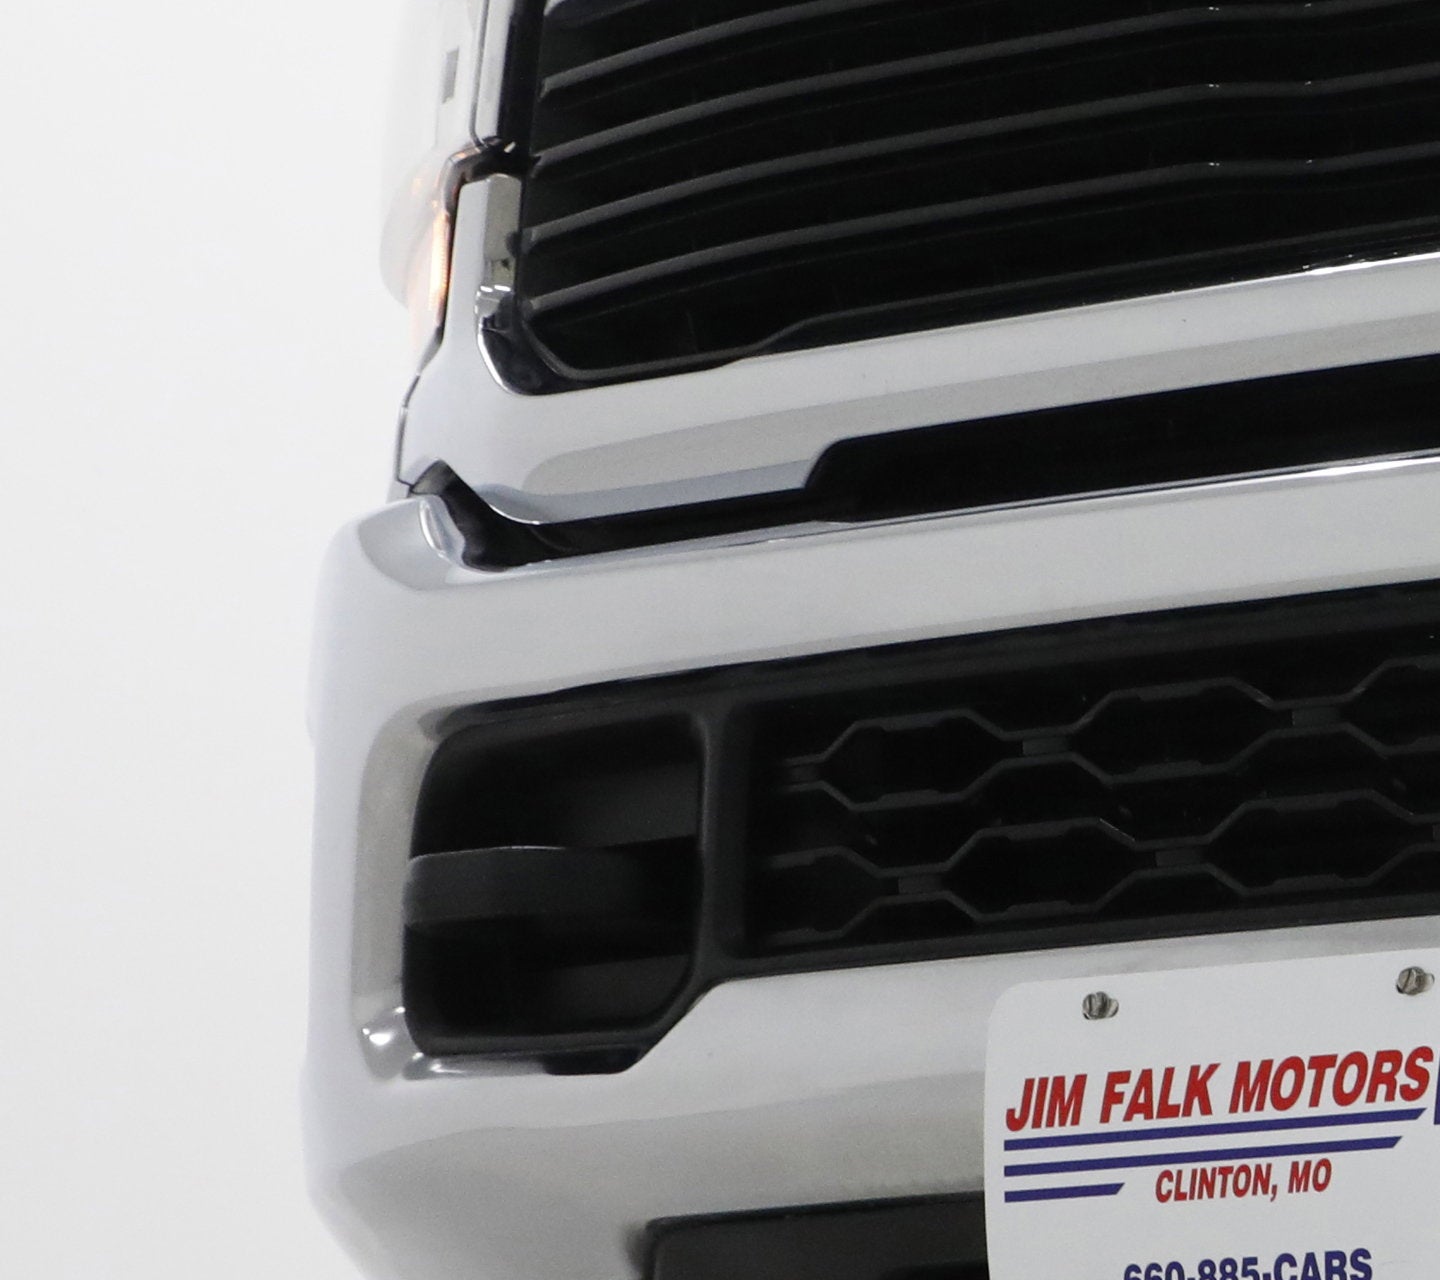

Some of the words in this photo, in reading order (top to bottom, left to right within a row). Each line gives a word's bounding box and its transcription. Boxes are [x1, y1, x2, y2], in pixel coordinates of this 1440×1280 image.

[1005, 1073, 1088, 1132] JIM
[1099, 1063, 1220, 1124] FALK
[1228, 1046, 1434, 1114] MOTORS
[1155, 1164, 1279, 1203] CLINTON,
[1288, 1159, 1332, 1193] MO
